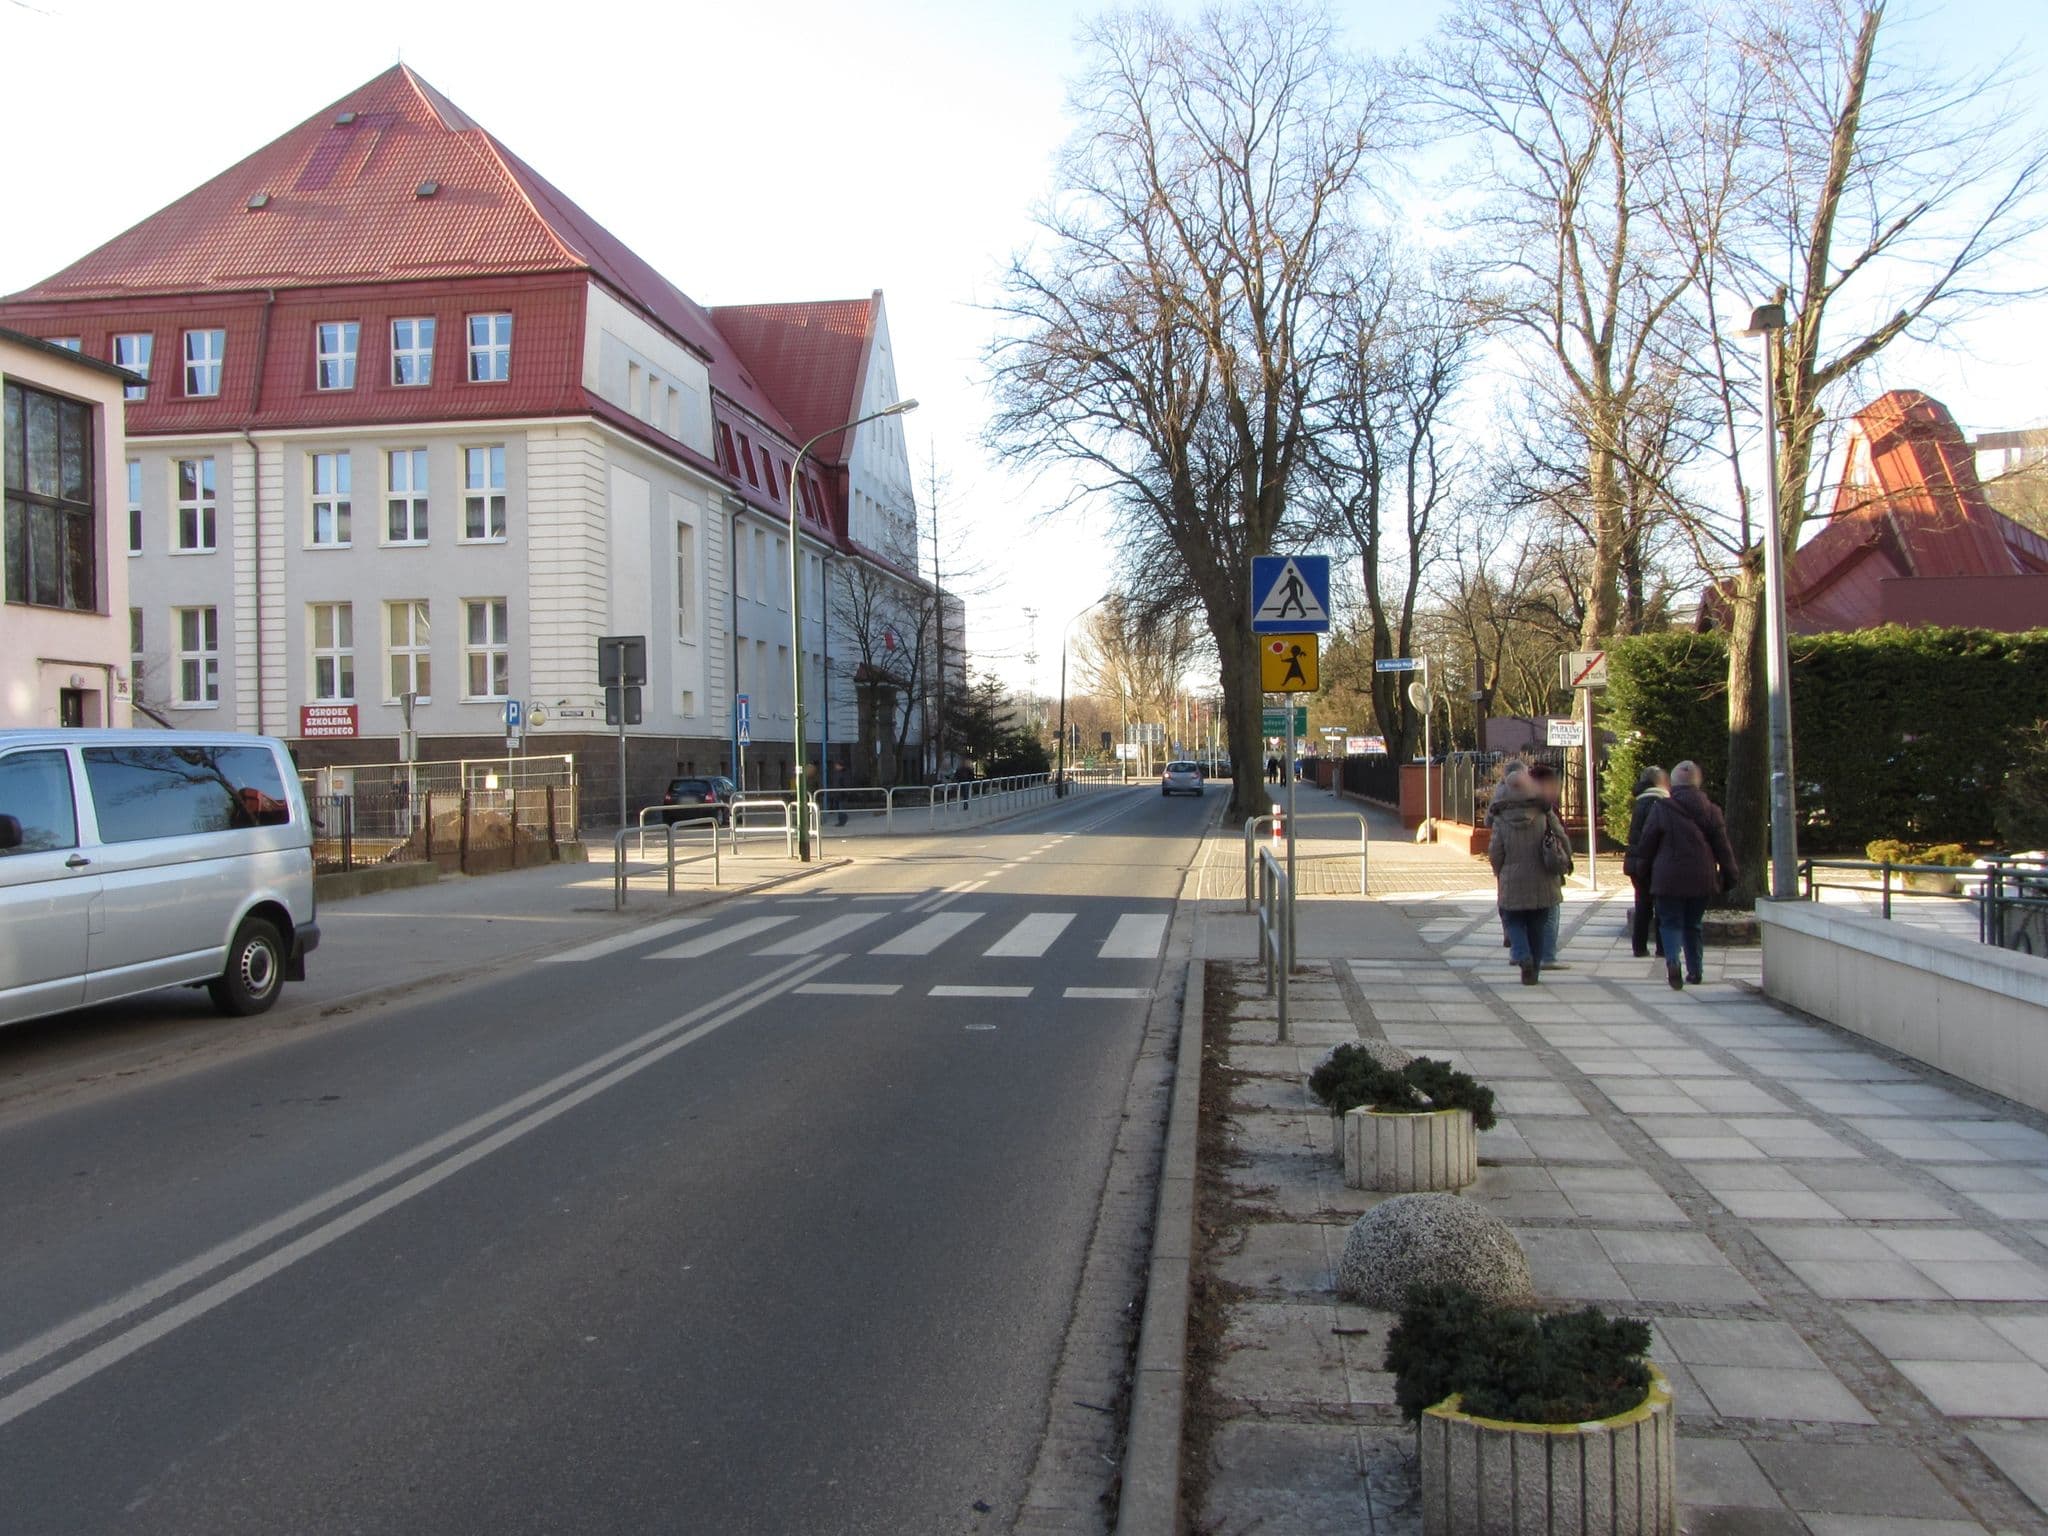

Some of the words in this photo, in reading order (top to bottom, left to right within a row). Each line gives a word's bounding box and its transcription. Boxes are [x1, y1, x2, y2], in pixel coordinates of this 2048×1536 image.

[509, 703, 517, 722] P
[306, 717, 352, 726] SZKOLENIA
[304, 727, 354, 736] MORSKIEGO
[1551, 725, 1582, 733] PARKING
